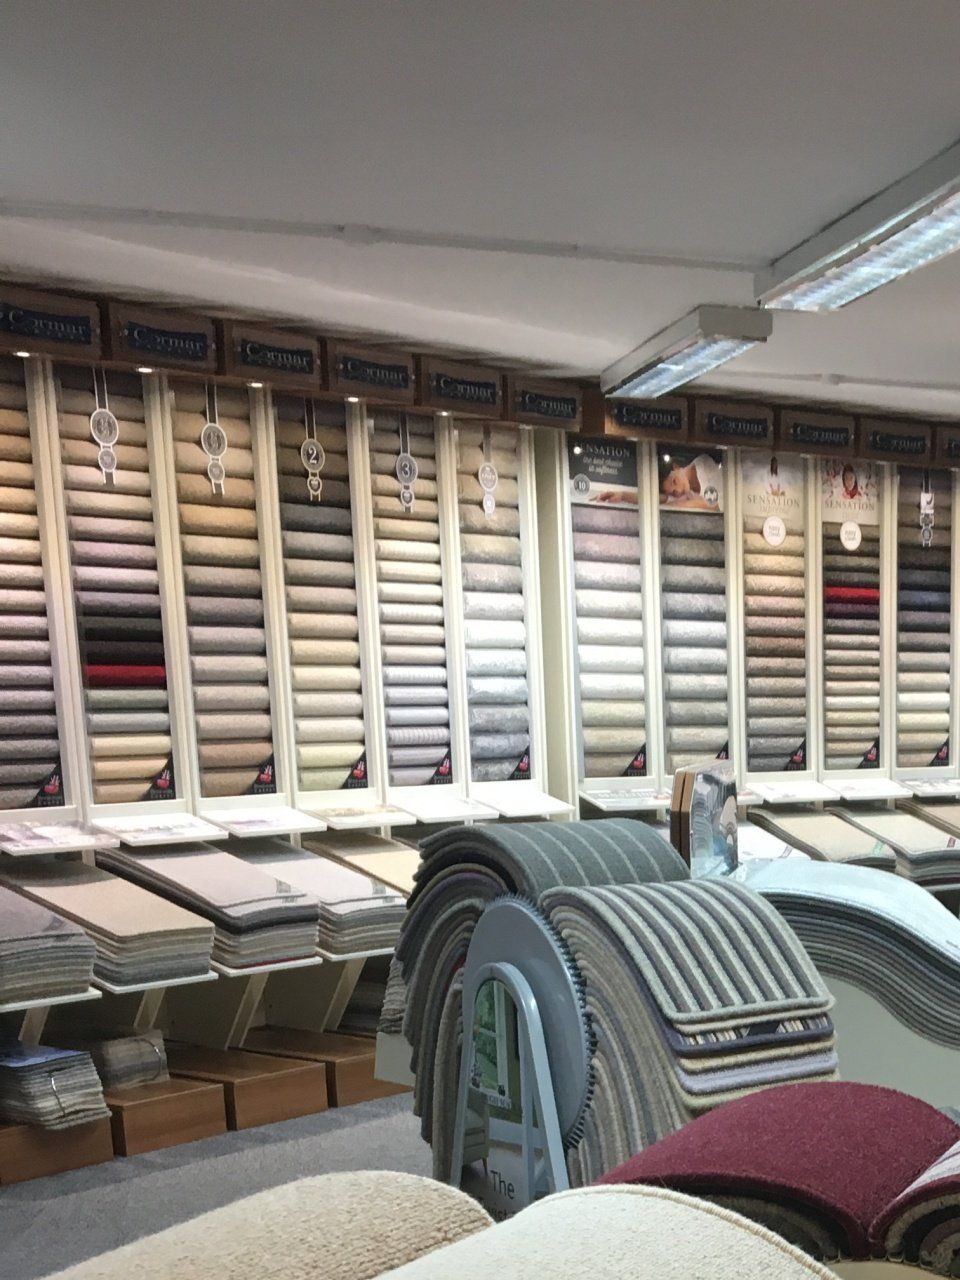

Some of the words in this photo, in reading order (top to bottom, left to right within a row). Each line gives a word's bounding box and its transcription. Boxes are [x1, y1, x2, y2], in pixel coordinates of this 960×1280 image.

[308, 447, 317, 464] 2
[401, 461, 411, 477] 3
[747, 494, 800, 508] SENSATION
[824, 500, 875, 511] SENSATION
[490, 1170, 516, 1200] The
